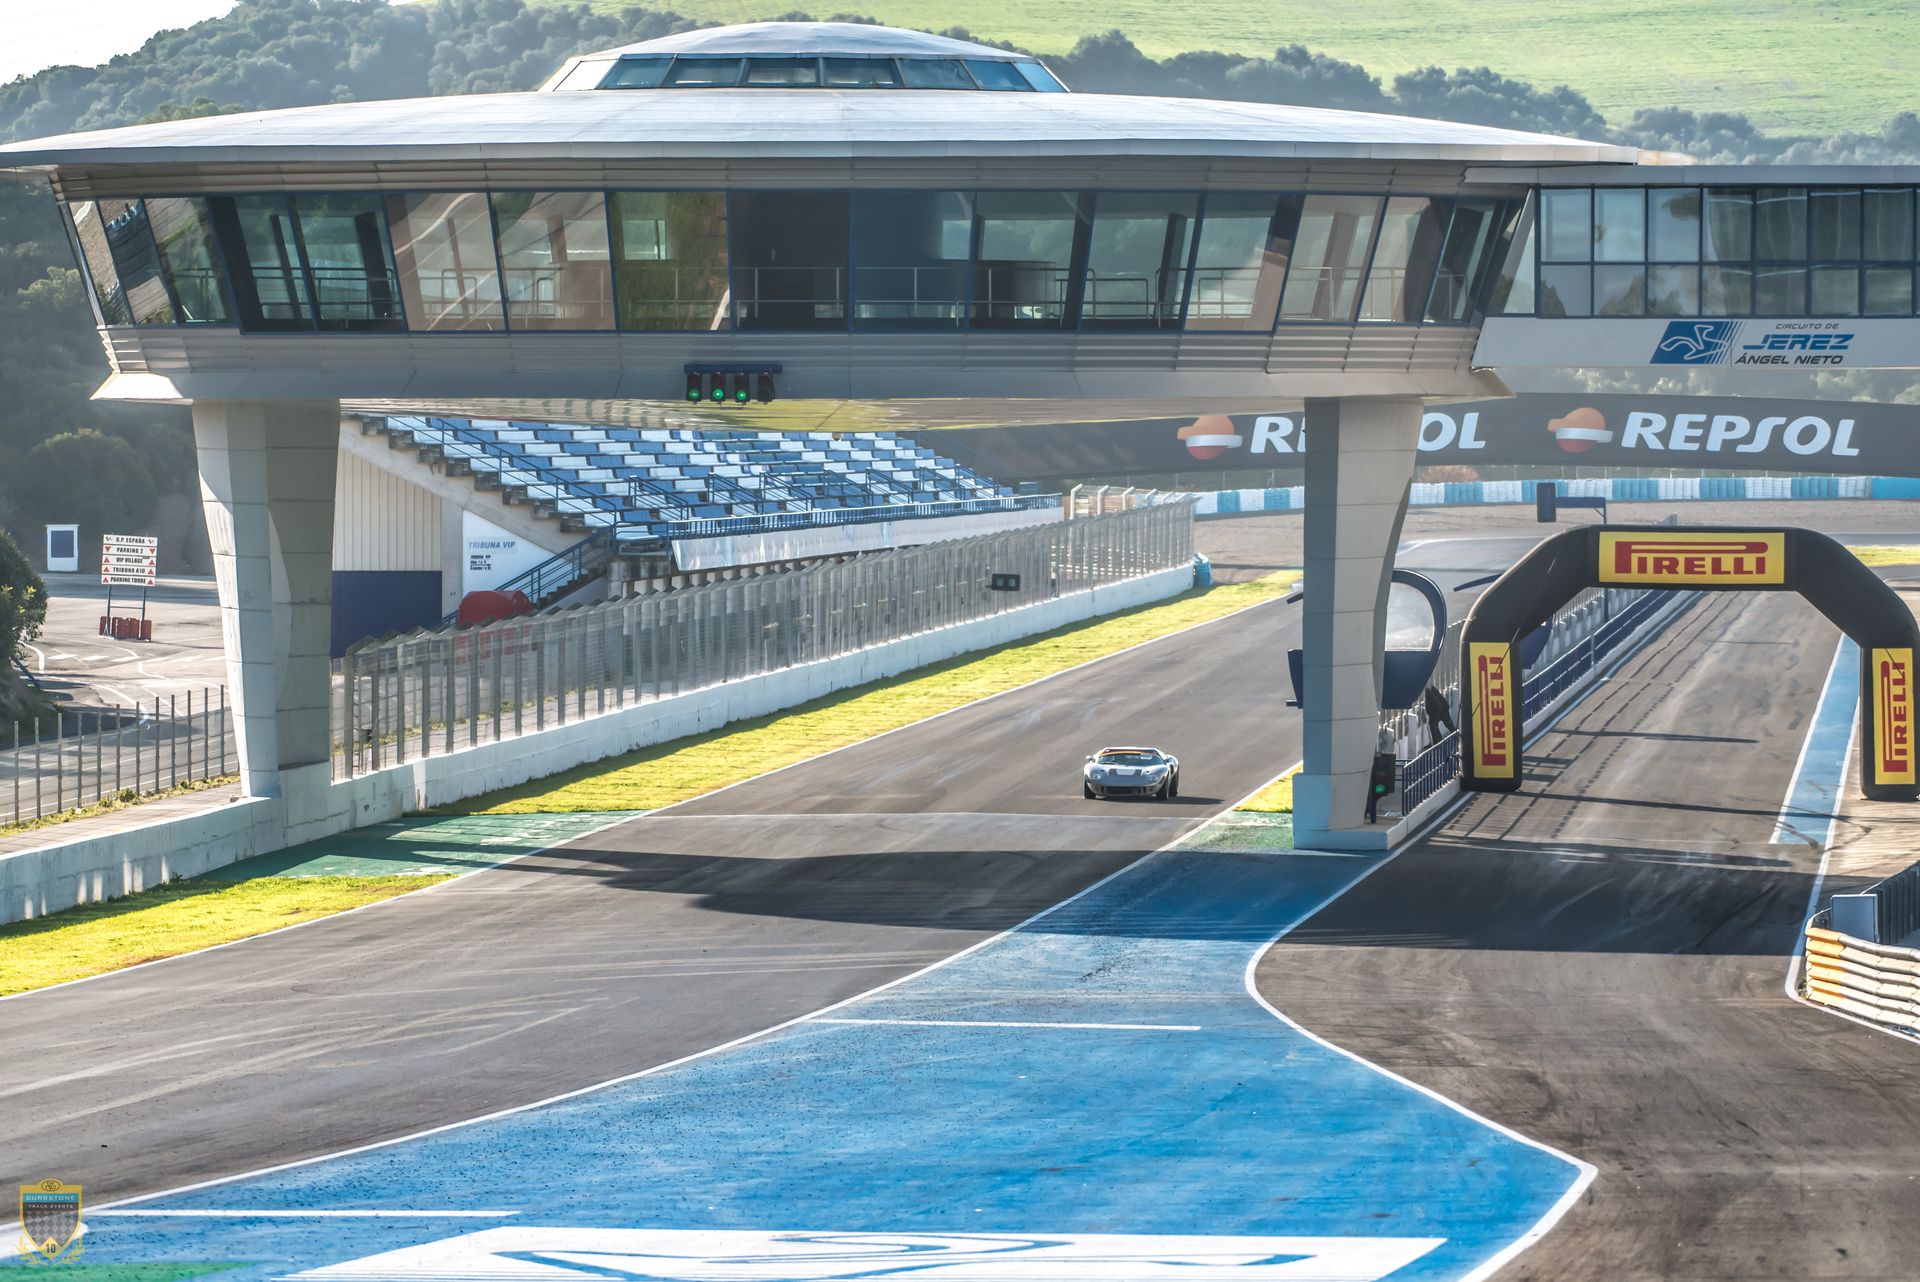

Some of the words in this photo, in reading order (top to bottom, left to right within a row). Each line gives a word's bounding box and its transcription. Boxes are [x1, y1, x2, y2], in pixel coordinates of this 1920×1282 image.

[1734, 352, 1789, 364] ÁNGEL
[1794, 355, 1844, 364] NIETO
[1743, 334, 1855, 350] JEREZ
[1621, 412, 1860, 456] REPSOL
[1615, 541, 1768, 575] PIRELLI
[1478, 655, 1507, 766] PIRELLI
[1880, 661, 1907, 773] PIRELLI
